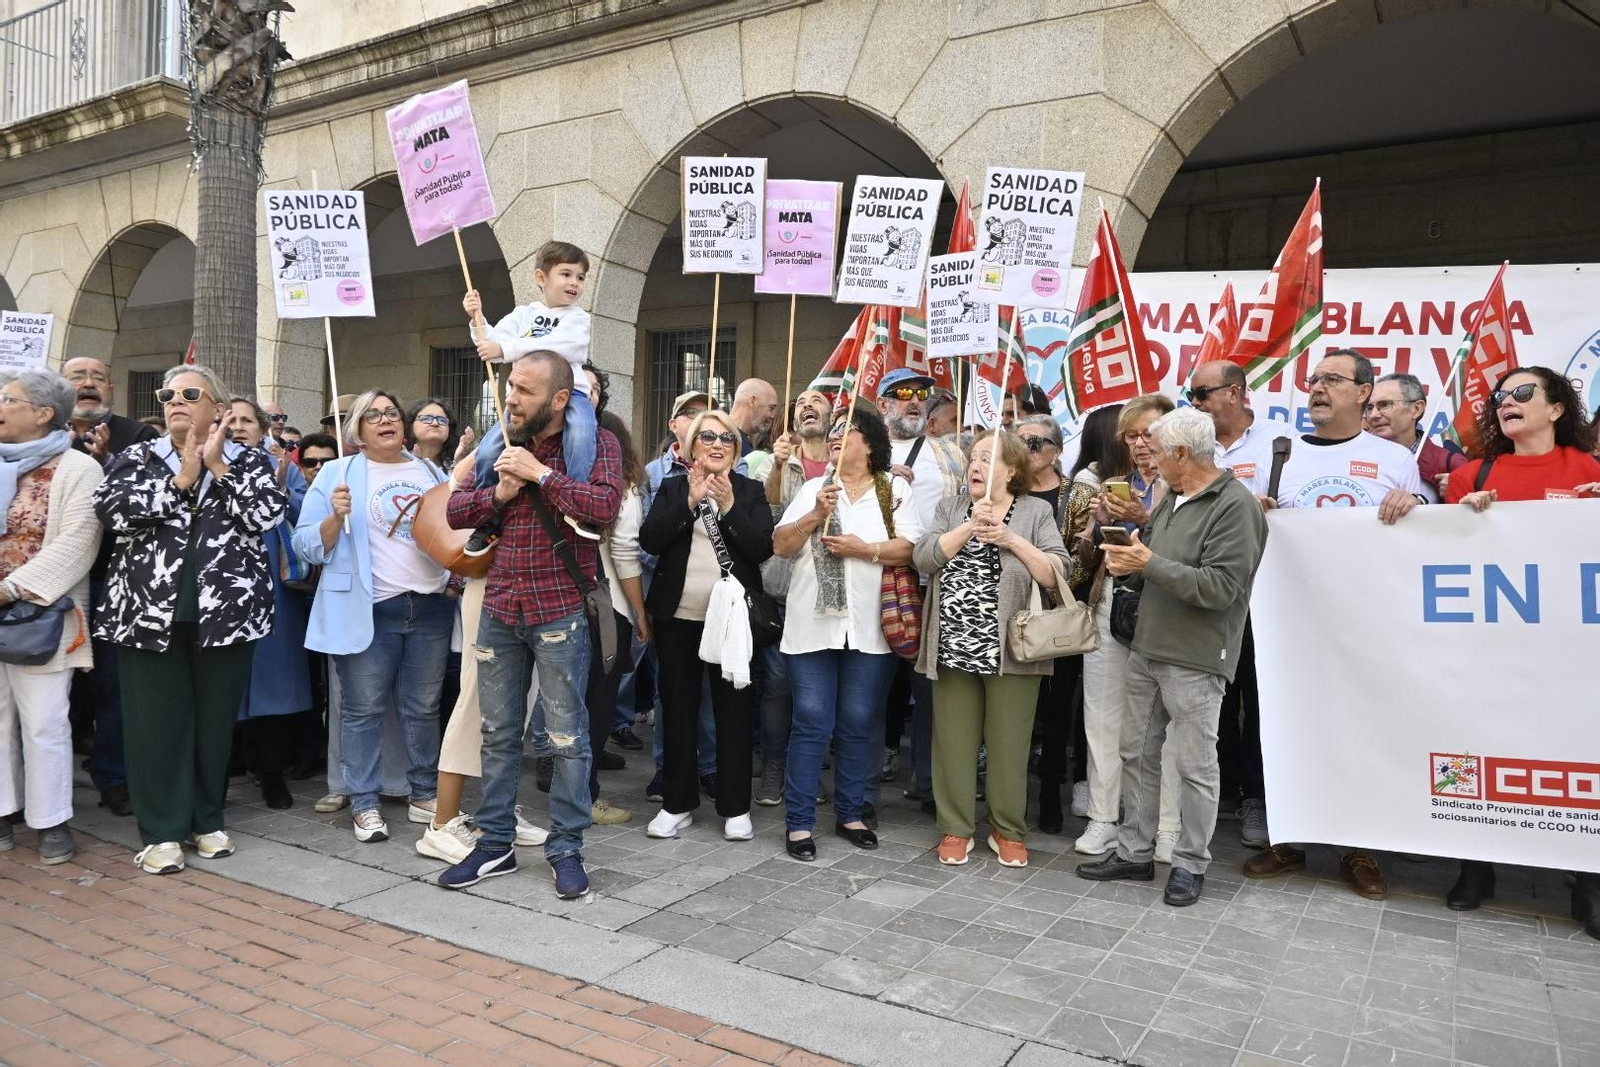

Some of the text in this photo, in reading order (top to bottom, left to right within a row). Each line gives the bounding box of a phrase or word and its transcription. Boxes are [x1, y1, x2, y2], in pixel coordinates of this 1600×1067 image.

[414, 126, 450, 152] MATA
[442, 169, 471, 185] Pública
[689, 165, 755, 178] SANIDAD
[689, 180, 755, 195] PÚBLICA
[990, 173, 1078, 194] SANIDAD
[424, 179, 463, 204] para todas!
[859, 186, 928, 201] SANIDAD
[269, 194, 358, 211] SANIDAD
[987, 190, 1074, 217] PÚBLICA
[689, 209, 721, 218] NUESTRAS
[855, 201, 924, 220] PÚBLICA
[271, 211, 361, 231] PÚBLICA
[778, 211, 813, 223] MATA
[689, 219, 708, 228] VIDAS
[689, 229, 721, 238] IMPORTAN
[1029, 226, 1056, 235] NUESTRAS
[704, 240, 716, 248] QUE
[851, 233, 884, 244] NUESTRAS
[849, 244, 867, 253] VIDAS
[1026, 242, 1053, 250] IMPORTAN
[689, 250, 733, 258] SUS NEGOCIOS
[797, 250, 822, 259] Pública
[848, 255, 882, 265] IMPORTAN
[775, 257, 812, 266] para todas!
[1035, 259, 1060, 268] NEGOCIOS
[860, 267, 872, 276] QUE
[844, 277, 888, 289] SUS NEGOCIOS
[931, 273, 973, 289] PÚBLI
[930, 299, 958, 308] NUESTRAS
[930, 309, 946, 318] VIDAS
[1042, 311, 1070, 326] BLA
[1321, 300, 1534, 336] BLANCA
[5, 316, 47, 326] SANIDAD
[930, 317, 959, 326] IMPORTAN
[943, 326, 954, 334] QUE
[930, 335, 941, 344] SUS
[941, 333, 970, 343] NEGOCIOS
[401, 482, 427, 495] BLANC
[1300, 478, 1365, 498] MAREA BLANCA
[1422, 564, 1540, 624] EN
[1431, 797, 1600, 822] Sindicato Provincial de sanid
[1431, 811, 1517, 827] sociosanitarios
[1520, 819, 1534, 829] de
[1538, 821, 1575, 833] CCOO
